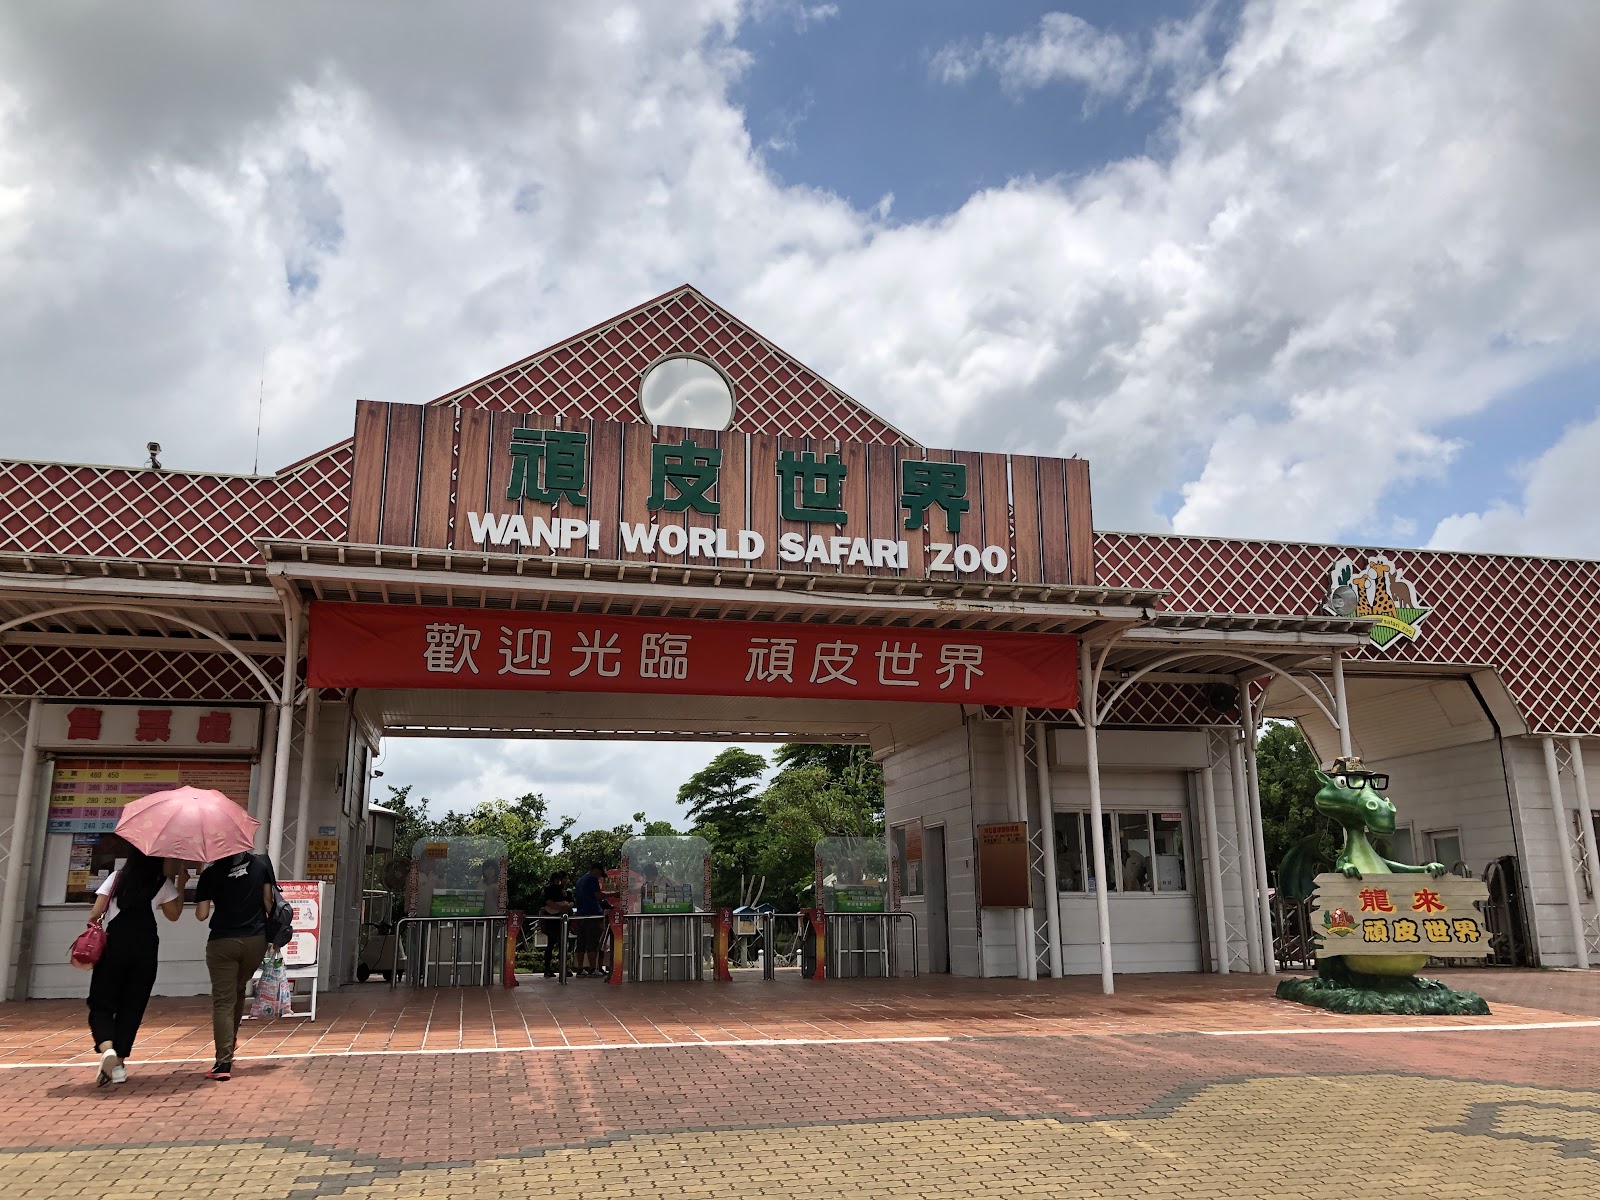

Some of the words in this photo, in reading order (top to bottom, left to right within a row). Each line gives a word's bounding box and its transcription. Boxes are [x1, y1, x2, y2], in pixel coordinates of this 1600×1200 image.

[507, 427, 970, 533] 頑皮世界
[467, 511, 601, 552] WANPI
[619, 519, 765, 562] WORLD
[779, 531, 909, 571] SAFARI
[929, 542, 1010, 575] ZOO
[1383, 619, 1400, 629] safari
[1401, 626, 1413, 635] zoo
[423, 621, 693, 682] 歡迎光臨
[744, 636, 985, 692] 頑皮世界
[67, 707, 232, 744] 售票處
[90, 771, 102, 779] 480
[107, 771, 120, 779] 450
[85, 809, 97, 817] 240
[102, 809, 115, 817] 240
[1358, 887, 1447, 915] 龍來
[1362, 918, 1482, 943] 頑皮世界
